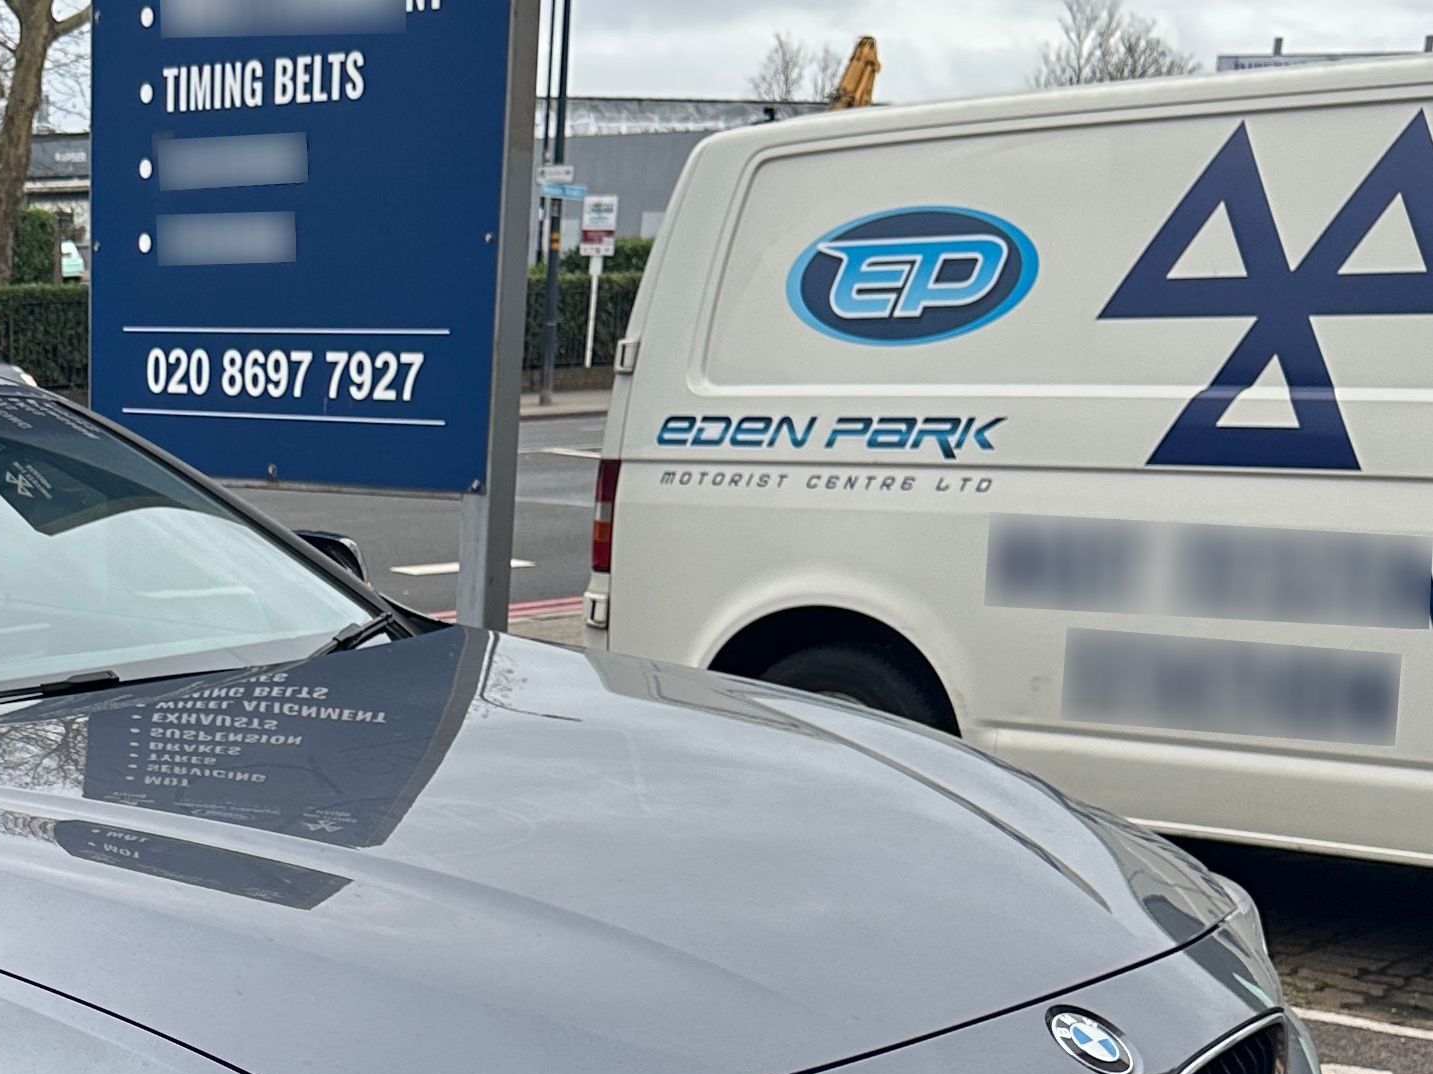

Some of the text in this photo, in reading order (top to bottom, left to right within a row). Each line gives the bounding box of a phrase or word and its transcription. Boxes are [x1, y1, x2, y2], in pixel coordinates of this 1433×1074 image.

[163, 51, 364, 112] TIMING BELTS
[147, 348, 424, 401] 020 8697 7927
[660, 471, 993, 494] MOTORIST CENTRE LTD
